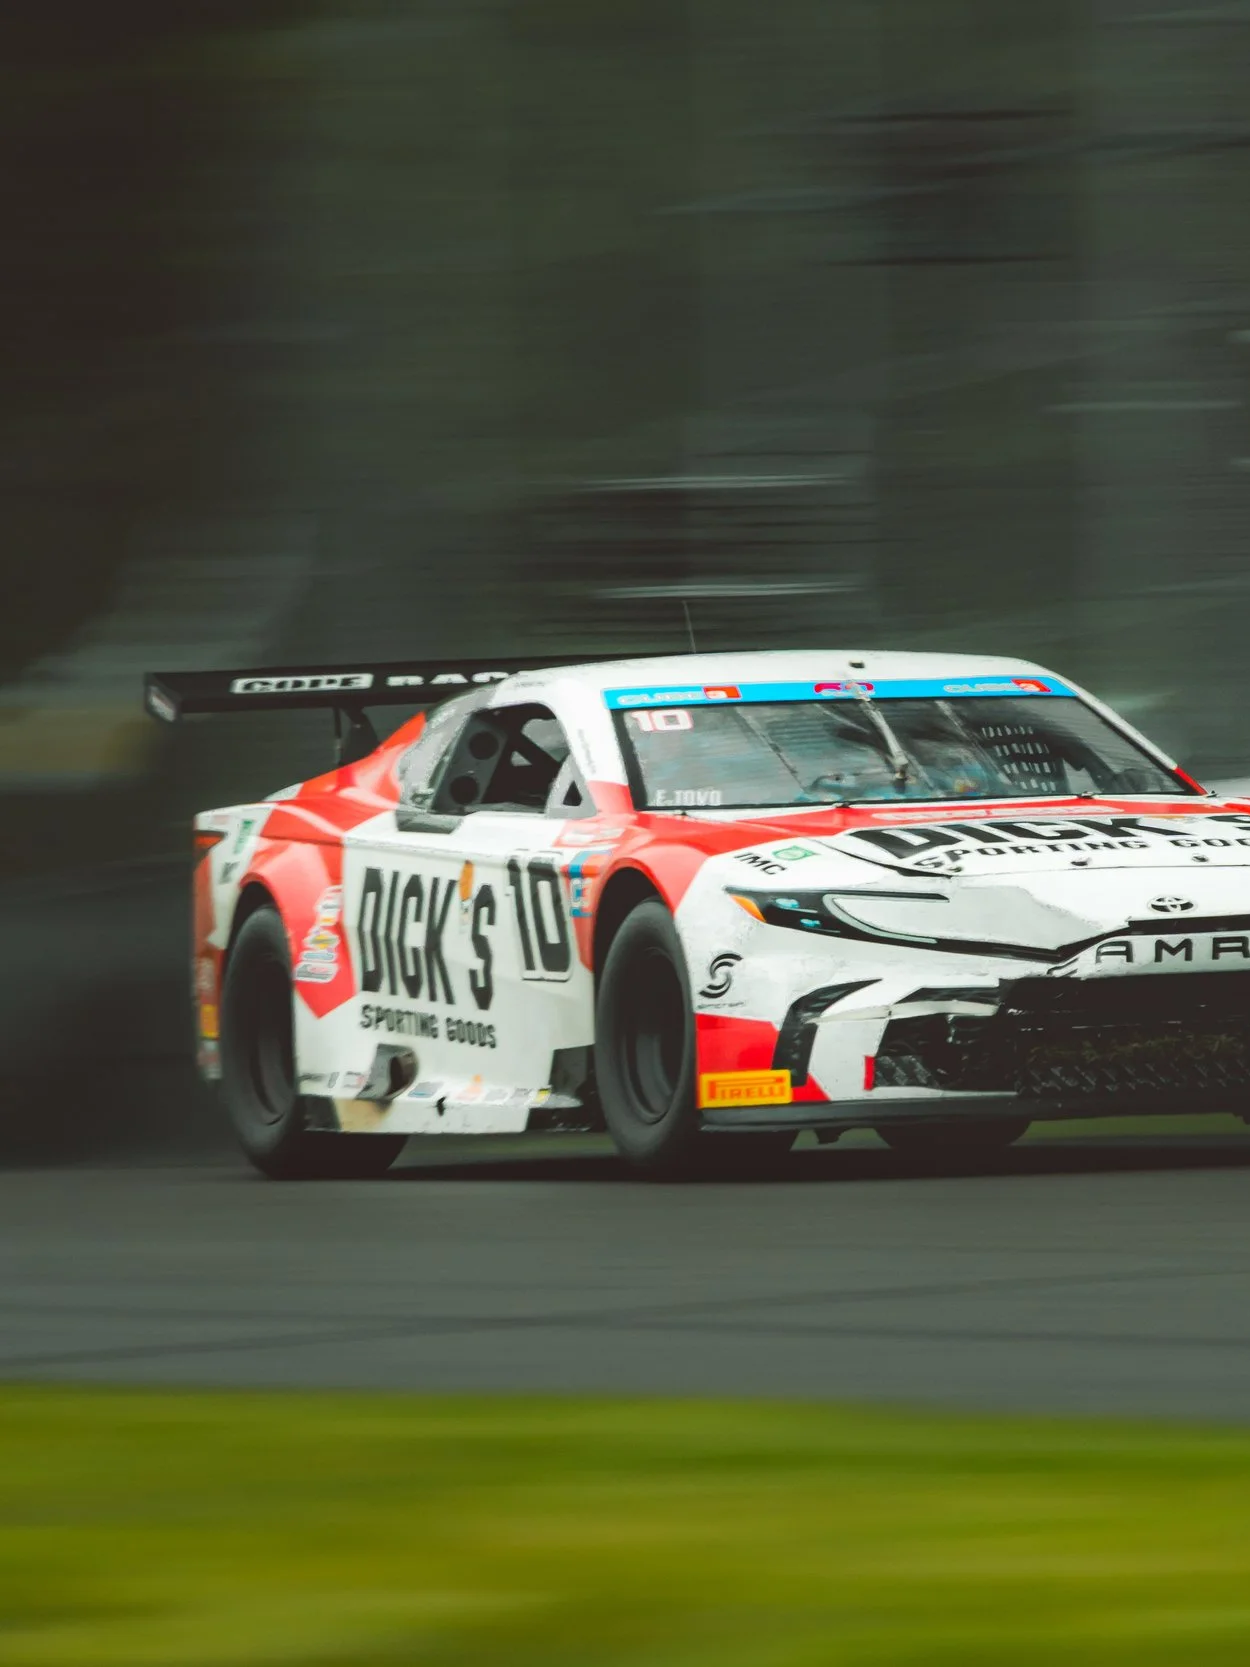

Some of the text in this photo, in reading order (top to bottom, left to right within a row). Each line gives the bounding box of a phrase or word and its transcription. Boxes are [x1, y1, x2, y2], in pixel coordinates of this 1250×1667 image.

[629, 708, 693, 732] 10
[733, 852, 787, 875] IMC
[913, 840, 1149, 869] SPORTING
[505, 857, 572, 972] 10
[356, 860, 496, 1011] DICK'S
[708, 1076, 787, 1099] PIRELLI
